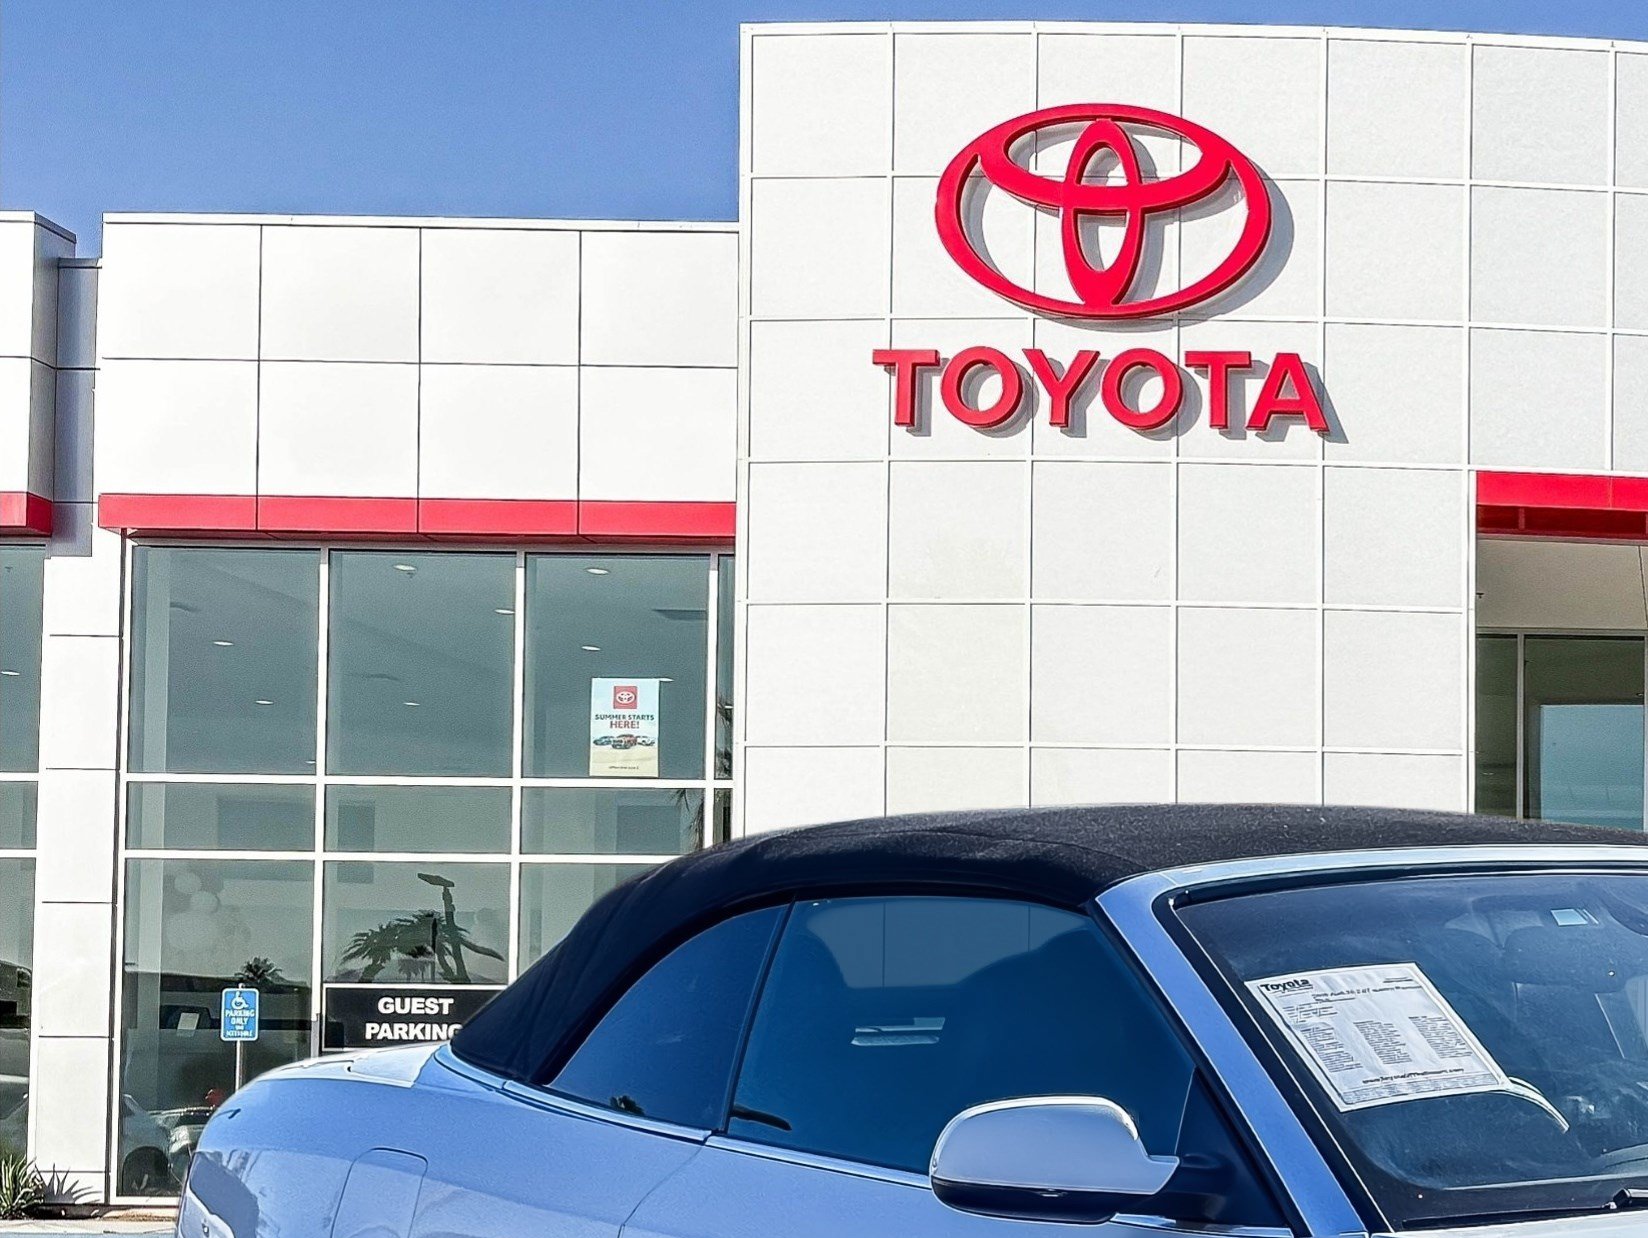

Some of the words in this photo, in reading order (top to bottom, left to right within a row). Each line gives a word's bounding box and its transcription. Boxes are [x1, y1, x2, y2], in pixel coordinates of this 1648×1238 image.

[872, 346, 1330, 433] TOYOTA
[609, 720, 640, 729] HERE!
[1259, 978, 1310, 994] Toyota
[225, 1009, 255, 1018] PARKING
[377, 996, 454, 1015] GUEST
